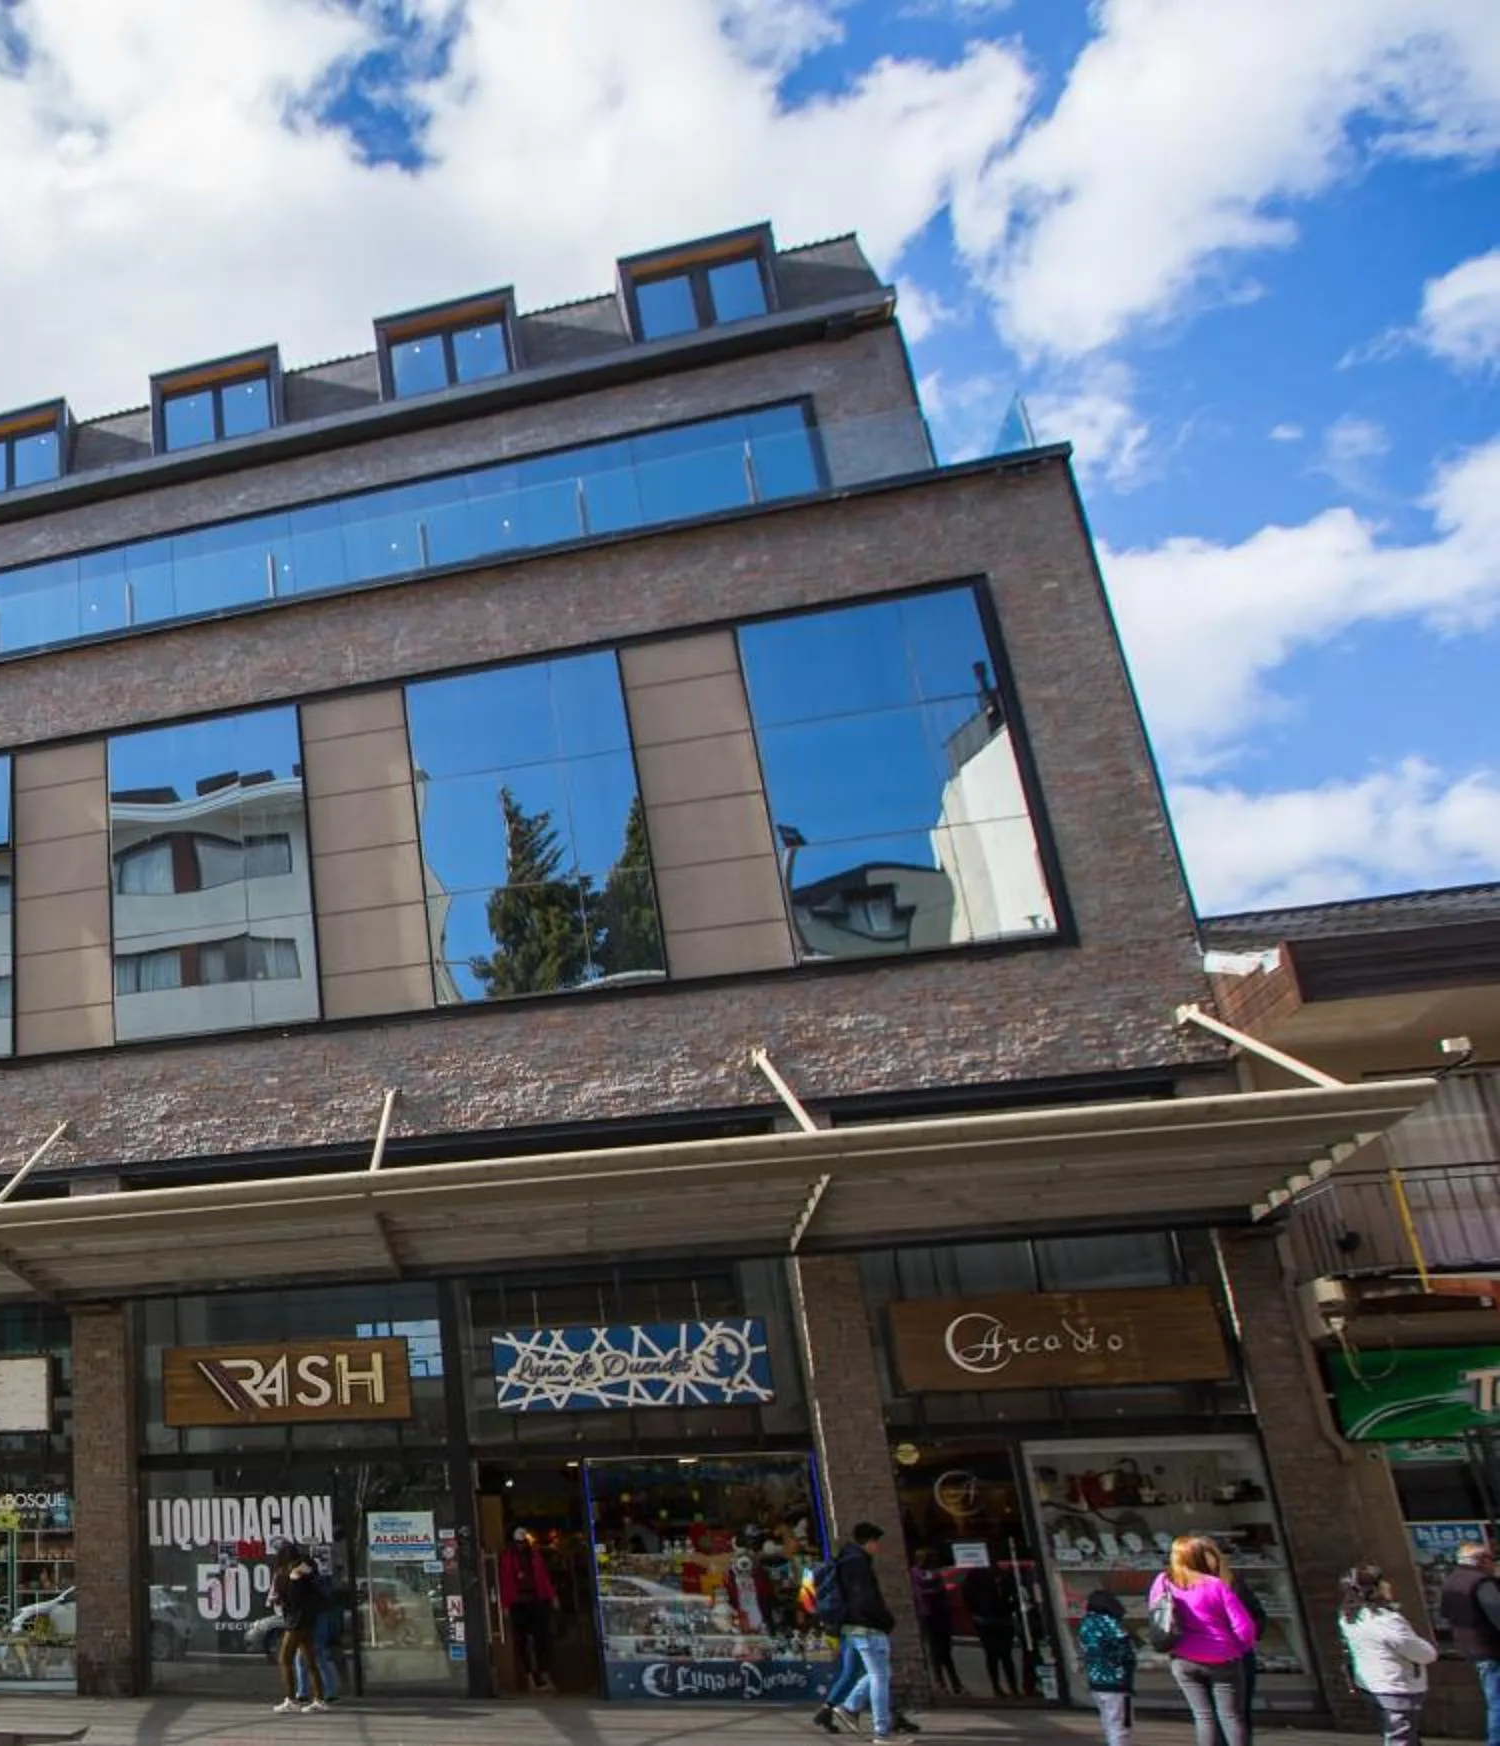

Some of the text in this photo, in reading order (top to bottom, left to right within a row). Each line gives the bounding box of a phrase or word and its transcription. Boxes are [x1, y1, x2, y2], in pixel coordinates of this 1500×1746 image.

[518, 1350, 693, 1380] Luna de Duendes
[198, 1353, 385, 1410] RASH
[6, 1492, 66, 1509] BOSQUE
